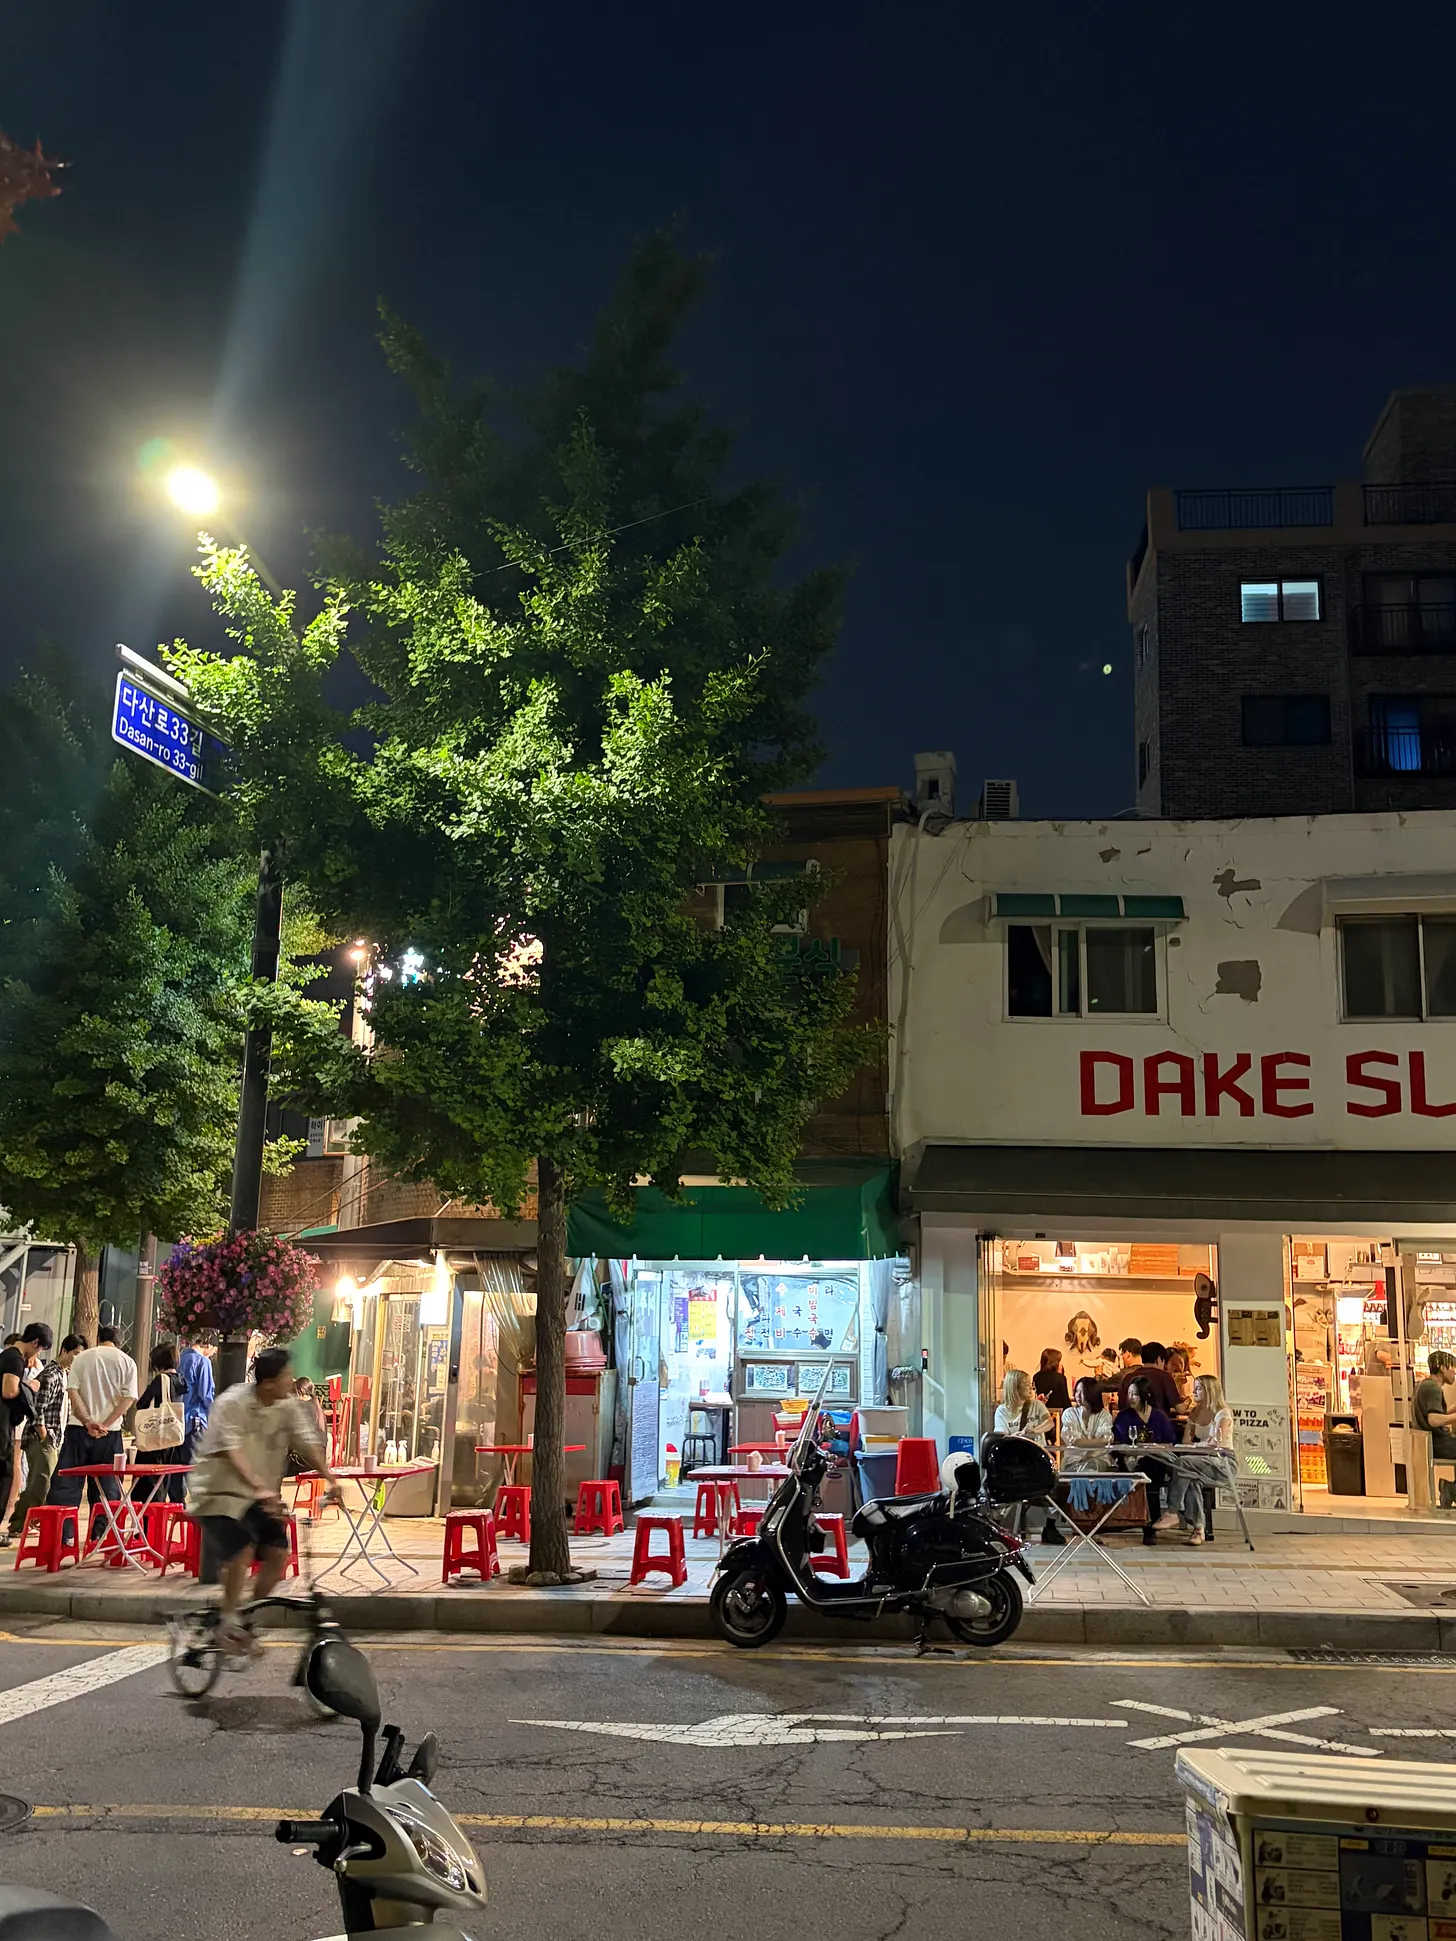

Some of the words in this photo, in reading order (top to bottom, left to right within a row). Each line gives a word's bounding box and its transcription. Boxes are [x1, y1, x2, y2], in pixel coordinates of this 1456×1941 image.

[119, 716, 171, 761] Dasan-ro
[122, 686, 204, 758] 다산로33길
[1079, 1050, 1314, 1118] DAKE
[1239, 1418, 1269, 1428] PIZZA
[1244, 1409, 1257, 1418] TO
